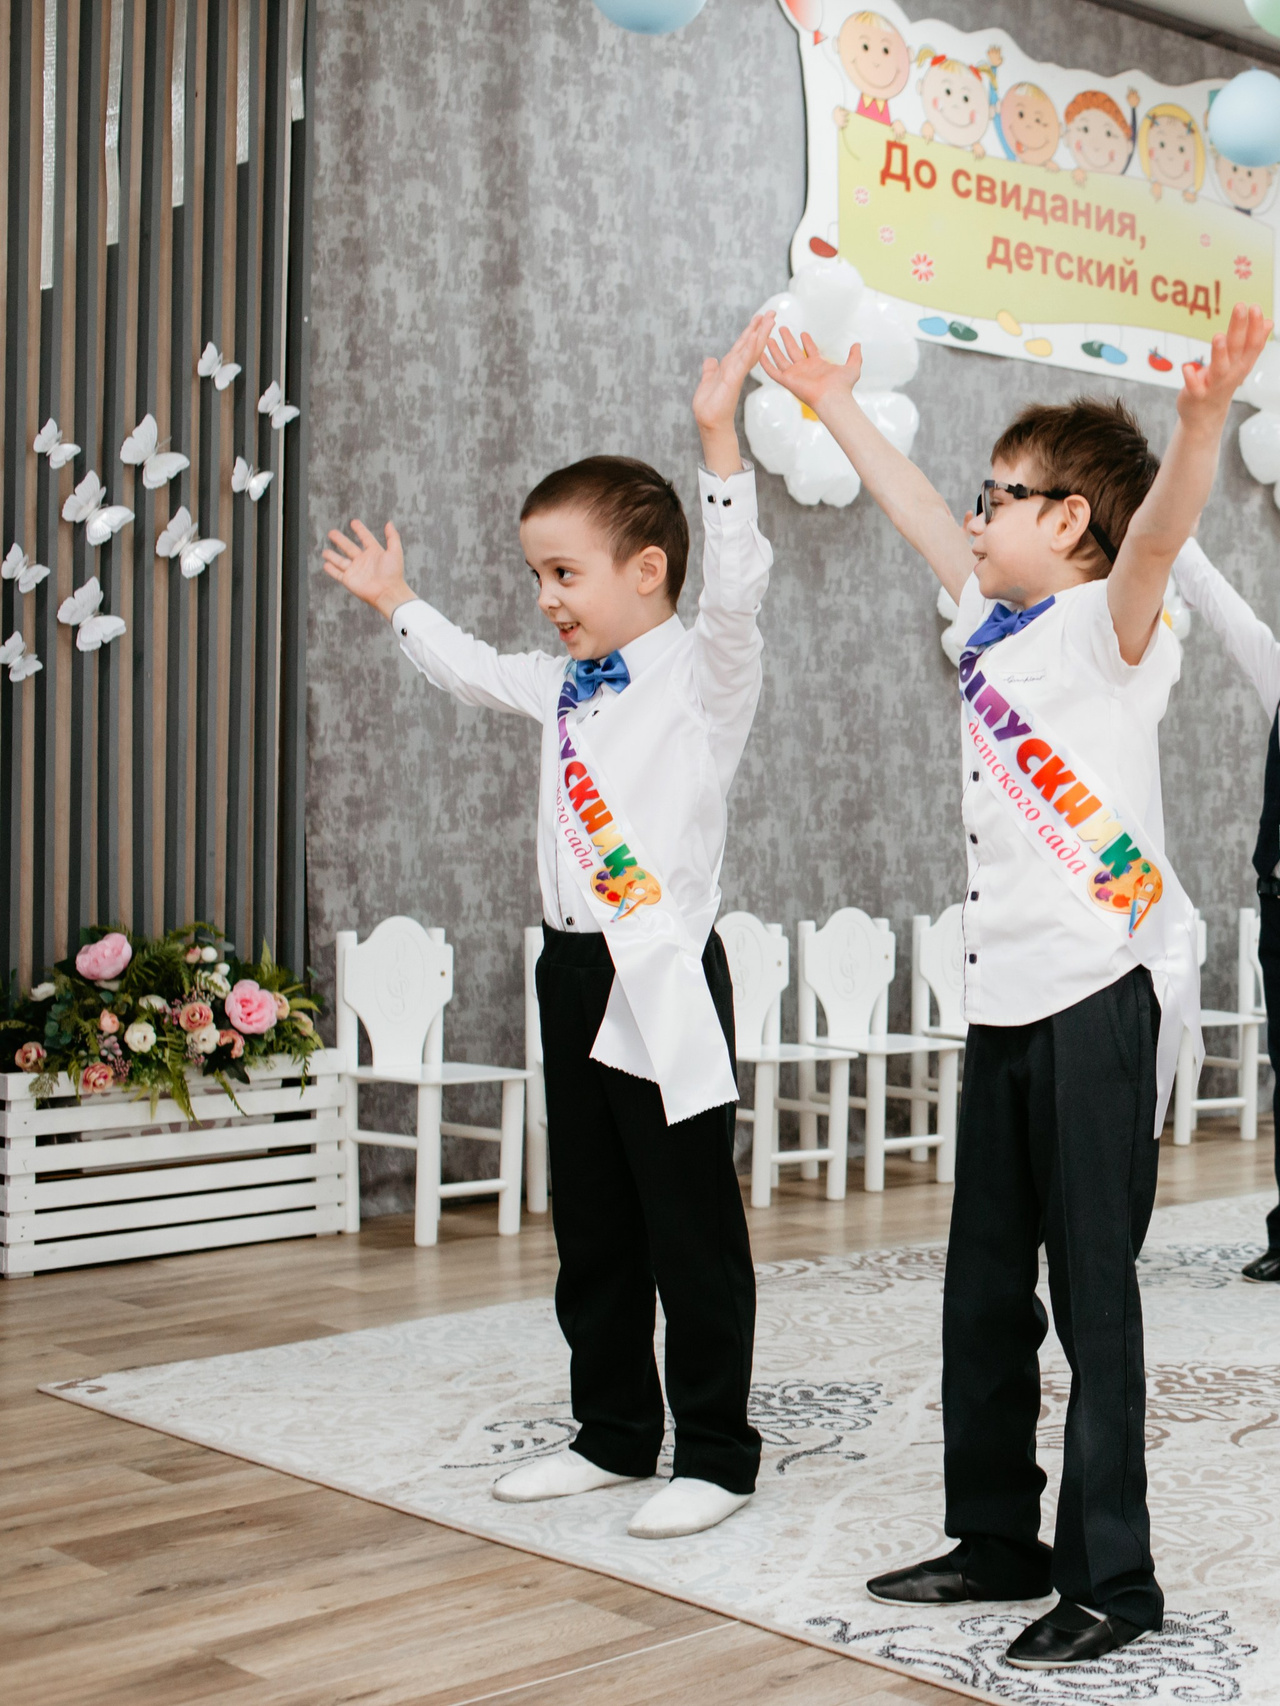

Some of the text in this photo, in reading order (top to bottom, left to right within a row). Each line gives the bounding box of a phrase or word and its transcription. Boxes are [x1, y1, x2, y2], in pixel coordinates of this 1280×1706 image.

[880, 139, 1147, 250] До свидания,
[986, 235, 1221, 320] детский сад!
[558, 681, 638, 879] УСКНИК
[959, 650, 1142, 879] ЫПУСКНИК
[967, 715, 1041, 822] детского
[1037, 823, 1089, 875] сада
[564, 828, 594, 870] сада
